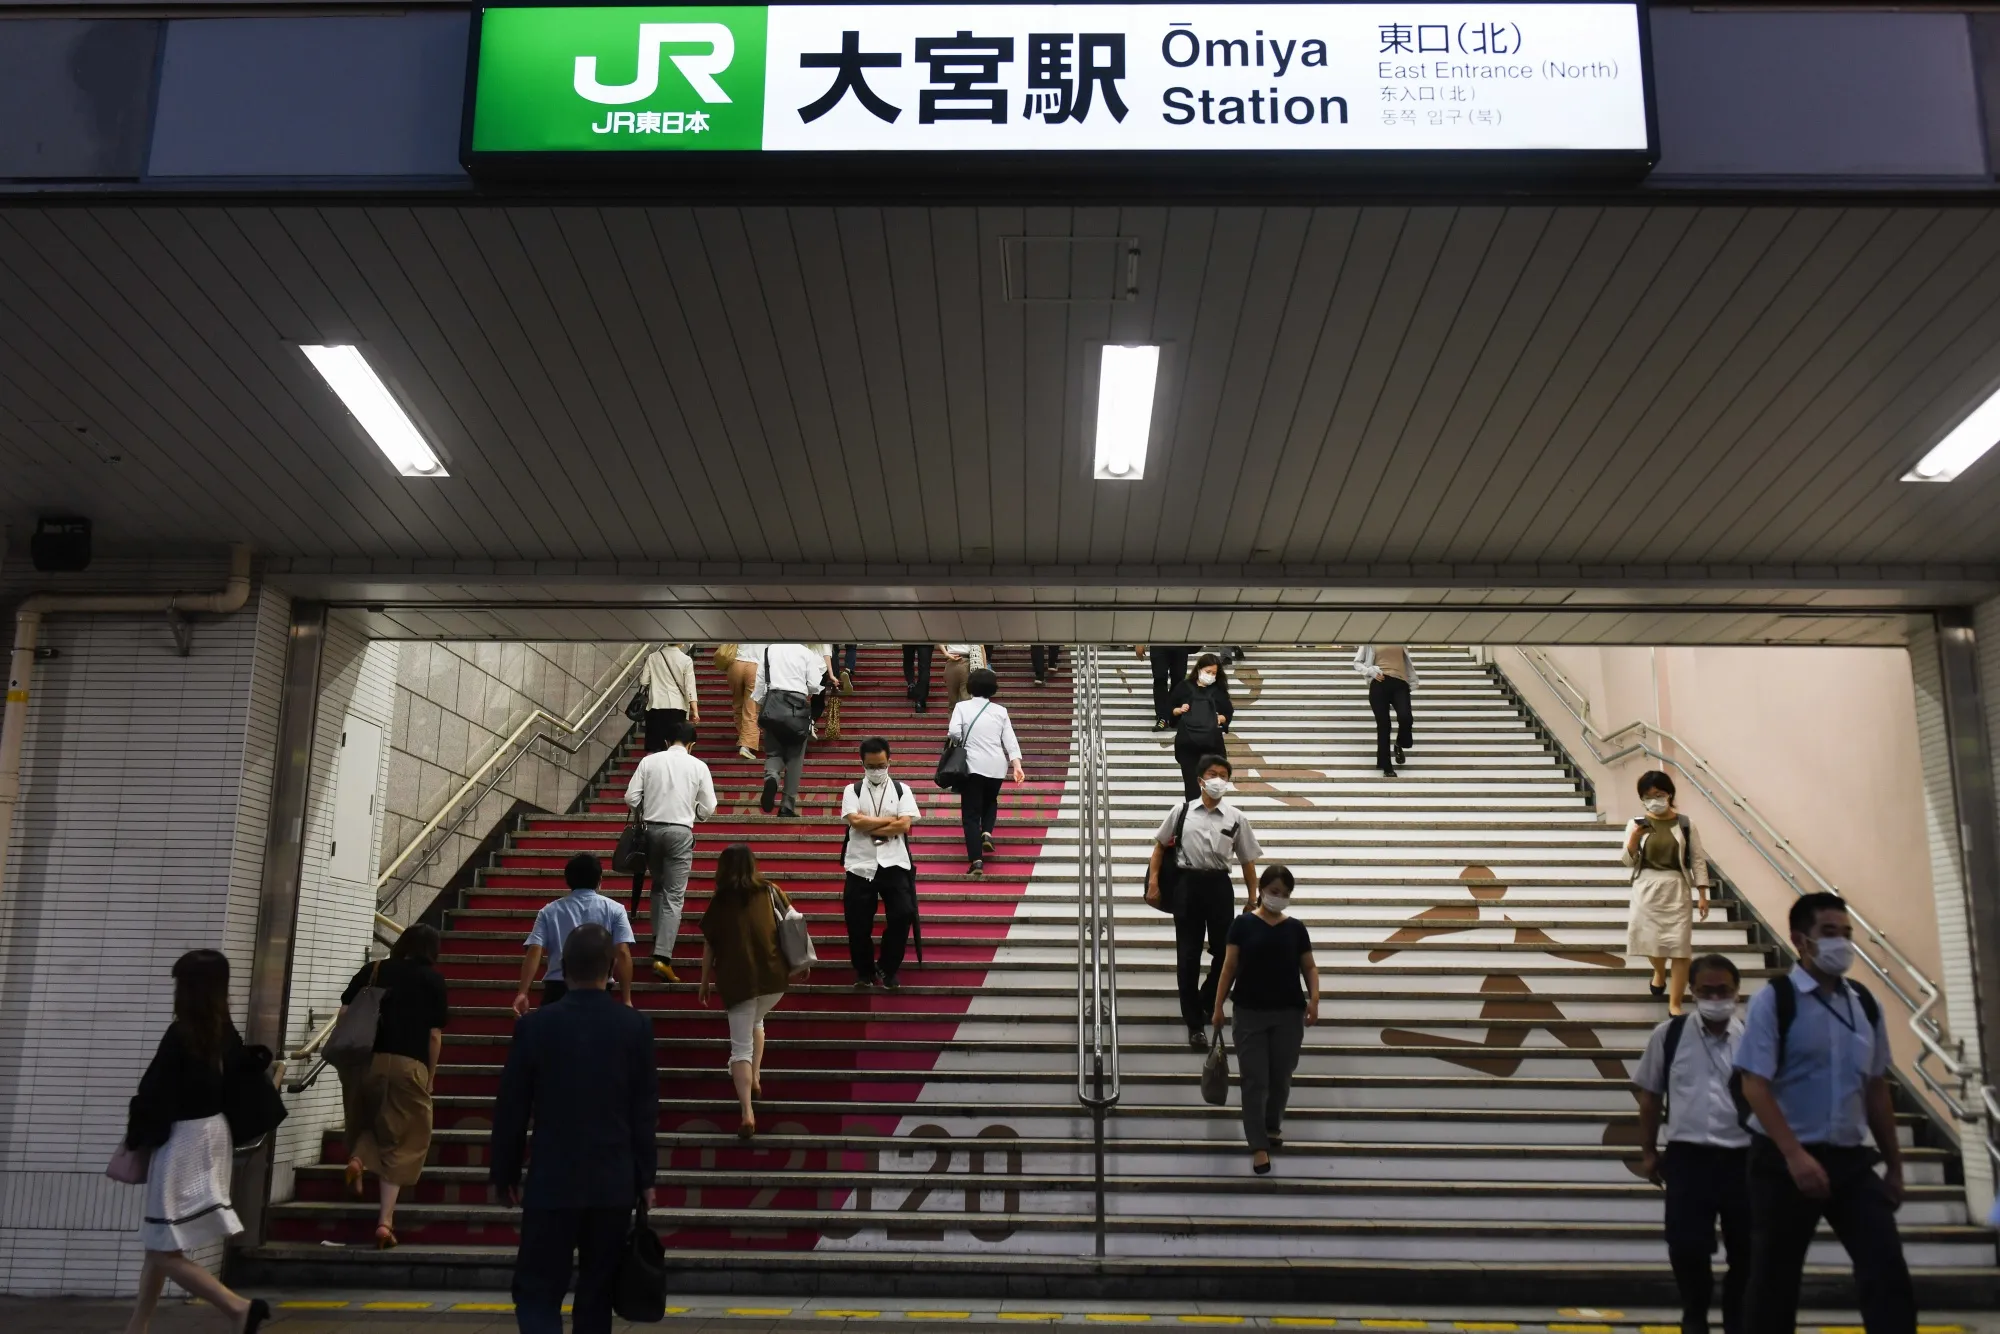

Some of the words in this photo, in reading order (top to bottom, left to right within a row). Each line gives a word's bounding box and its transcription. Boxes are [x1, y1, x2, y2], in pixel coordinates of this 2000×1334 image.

[1161, 22, 1328, 77] Ōmiya
[1378, 22, 1522, 55] 東口(北)
[573, 23, 735, 104] JR
[797, 31, 1130, 125] 大宮駅
[1378, 59, 1427, 79] East
[1435, 59, 1533, 79] Entrance
[1542, 59, 1619, 80] (North)
[1162, 86, 1349, 126] Station
[1379, 85, 1476, 102] 东入口(北)
[591, 110, 710, 134] JR東日本
[1380, 108, 1417, 127] 동쪽
